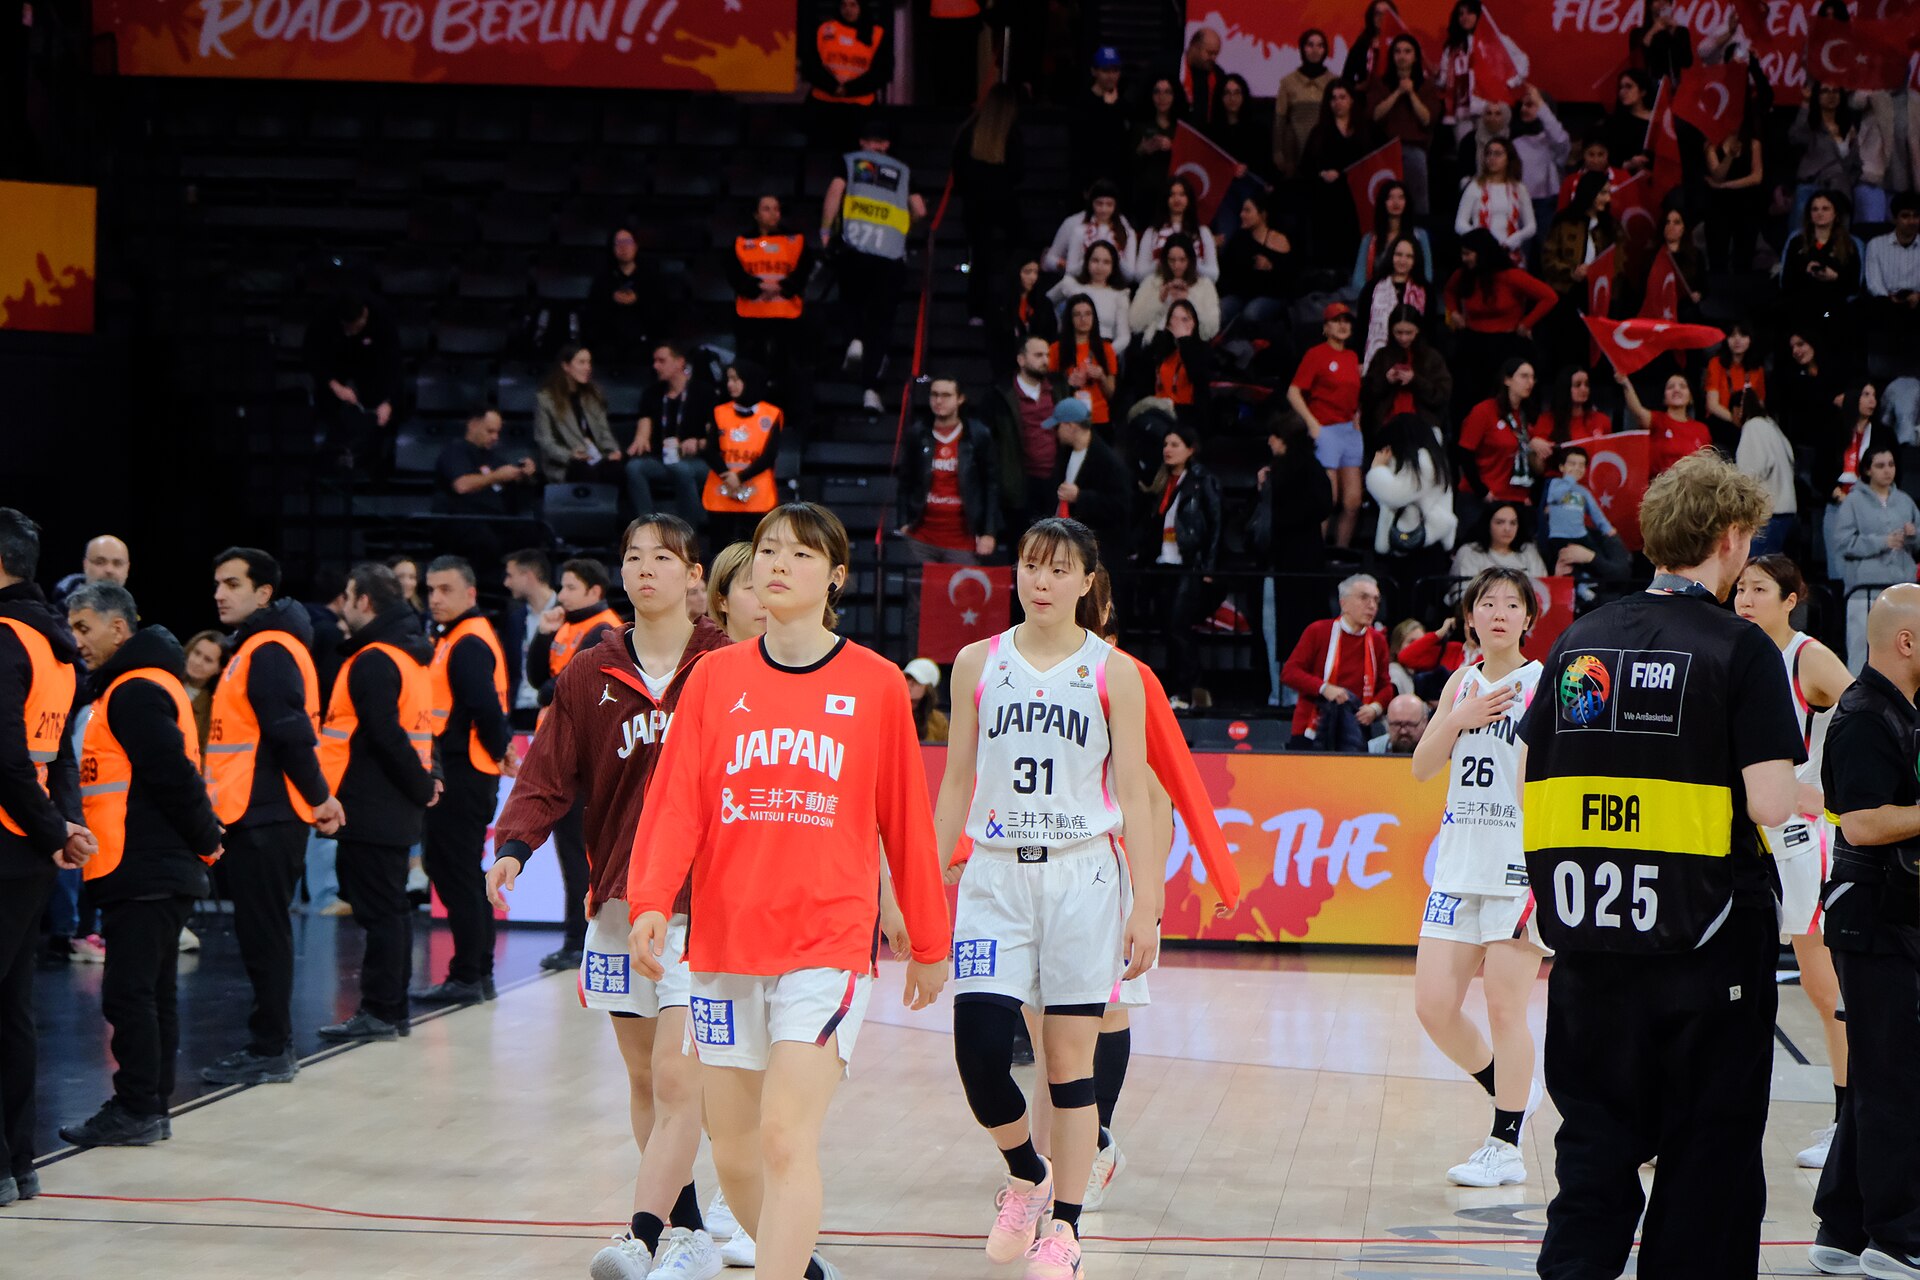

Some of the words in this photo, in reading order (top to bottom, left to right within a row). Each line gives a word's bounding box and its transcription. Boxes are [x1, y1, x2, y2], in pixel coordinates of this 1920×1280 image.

[199, 0, 371, 59] ROAD
[1551, 0, 1645, 34] FIBA
[848, 221, 884, 249] 271
[1630, 662, 1676, 689] FIBA
[617, 709, 675, 759] JAP
[988, 702, 1090, 748] JAPAN
[726, 728, 845, 782] JAPAN
[1013, 756, 1054, 795] 31
[1461, 756, 1494, 787] 26
[749, 787, 839, 815] 三井不動産
[1456, 801, 1516, 819] 三井不動産
[1582, 793, 1640, 832] FIBA
[749, 811, 784, 822] MITSUI
[787, 812, 834, 828] FUDOSAN
[1006, 830, 1039, 839] MITSUI
[1042, 830, 1092, 840] FUDOSAN
[1007, 811, 1088, 830] 三井不動産
[1478, 818, 1517, 828] FUDOSAN
[1261, 808, 1400, 889] THE
[1553, 860, 1660, 932] 025
